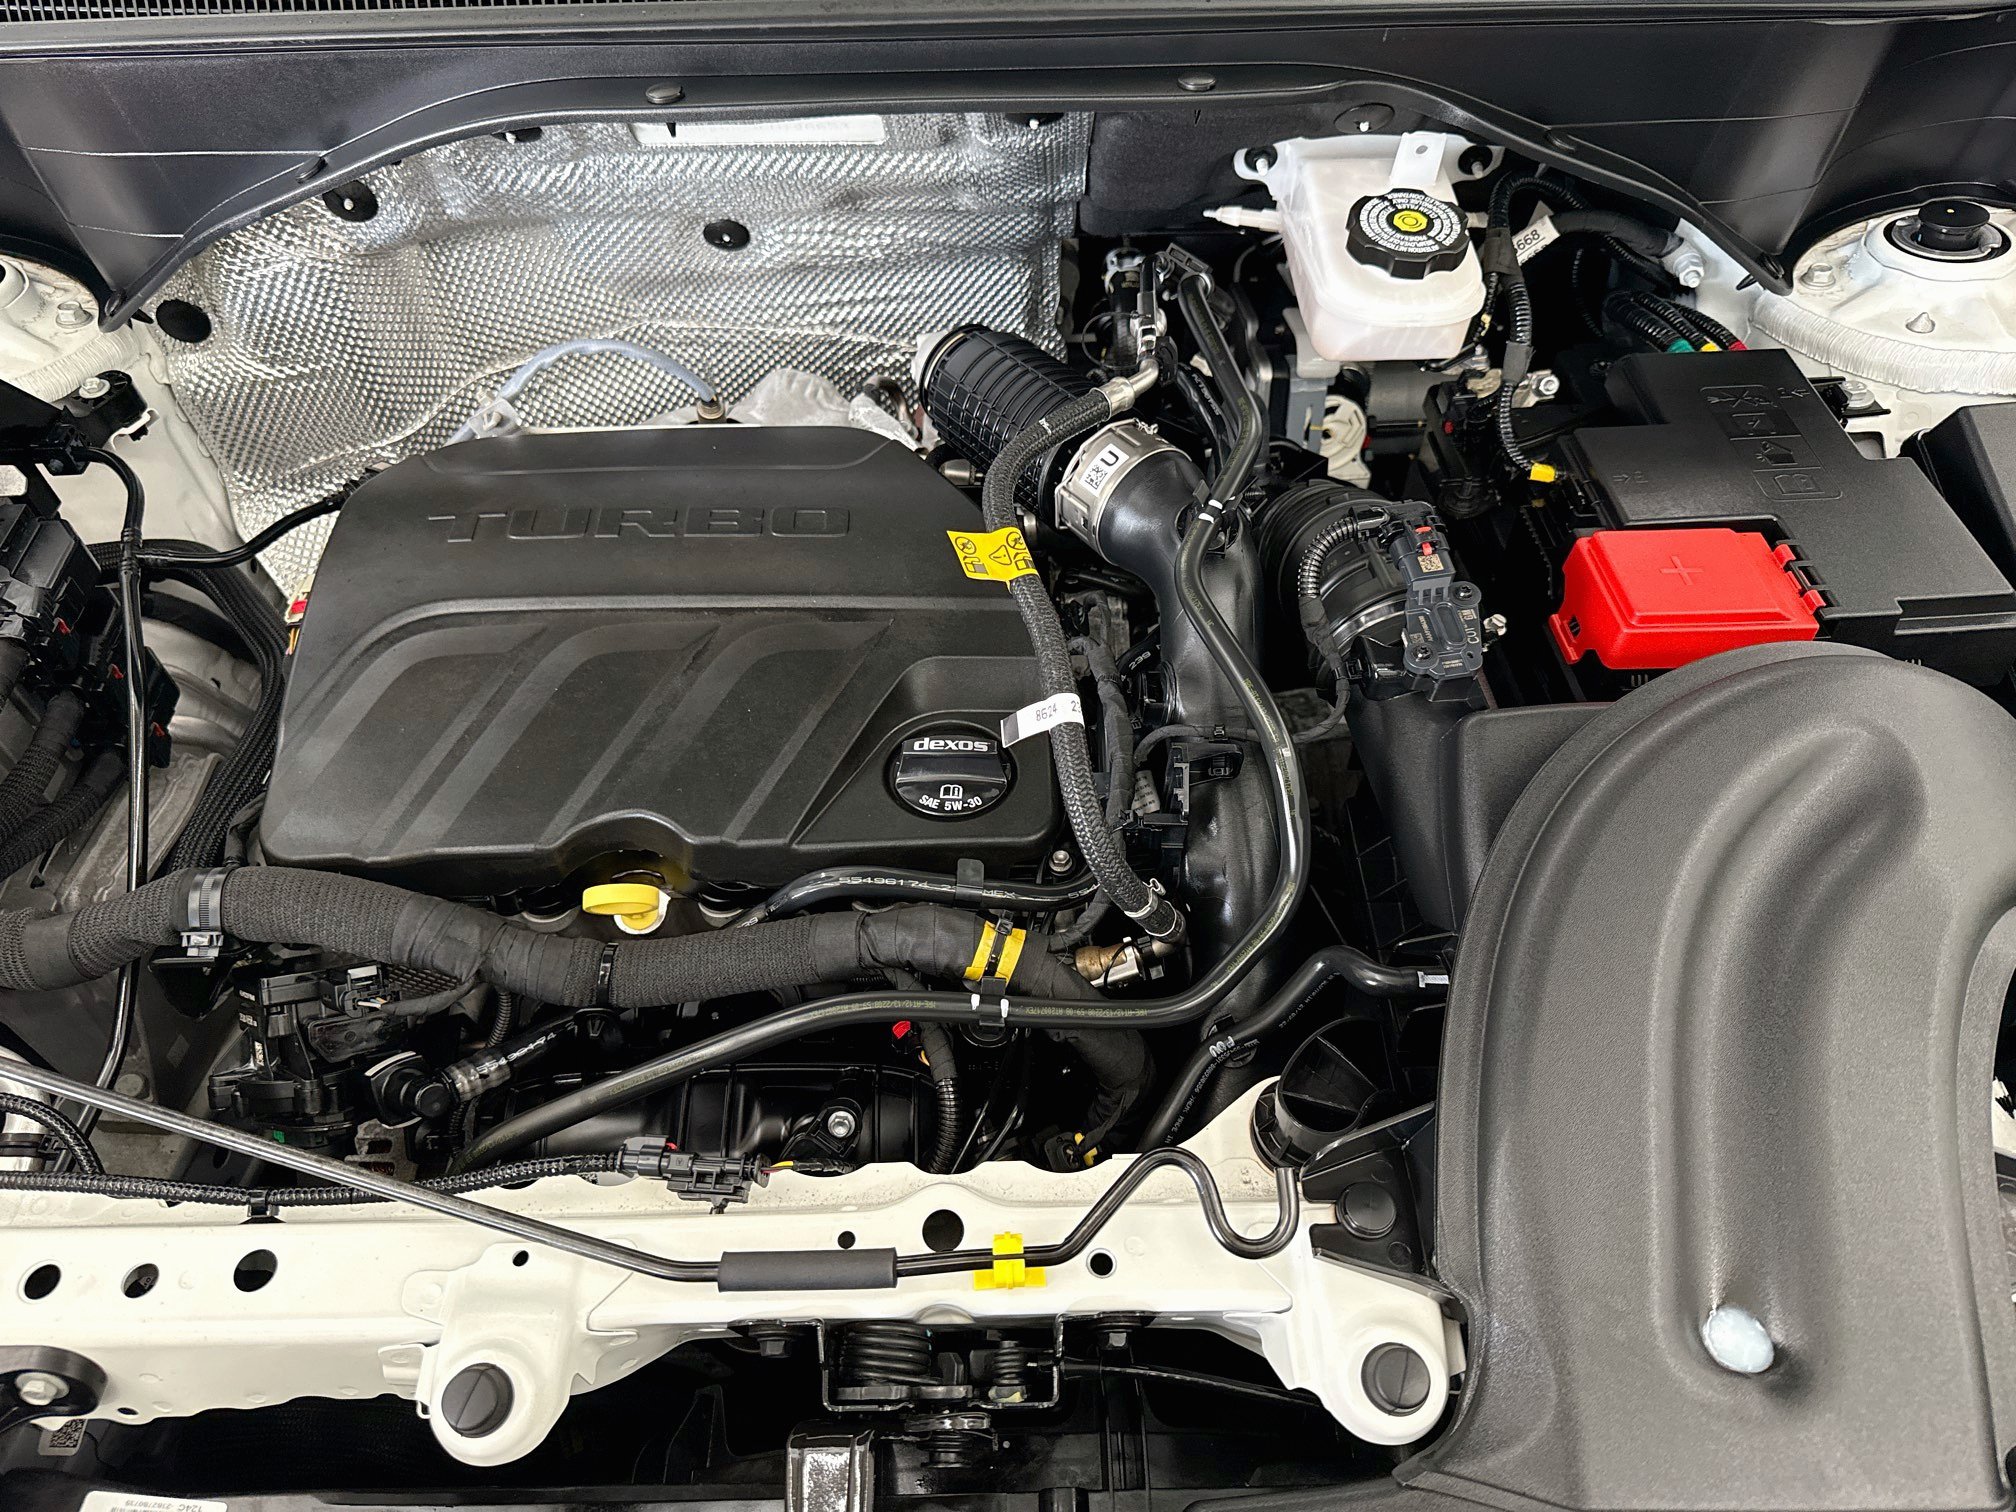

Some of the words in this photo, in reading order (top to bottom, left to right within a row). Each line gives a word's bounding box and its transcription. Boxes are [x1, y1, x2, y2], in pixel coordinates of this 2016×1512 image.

[1516, 229, 1540, 250] 668
[1100, 450, 1120, 467] U
[428, 504, 851, 543] TURBO
[1035, 702, 1058, 722] 8624
[913, 737, 989, 753] dexos
[919, 794, 940, 810] SAE
[944, 795, 983, 811] 5W-30
